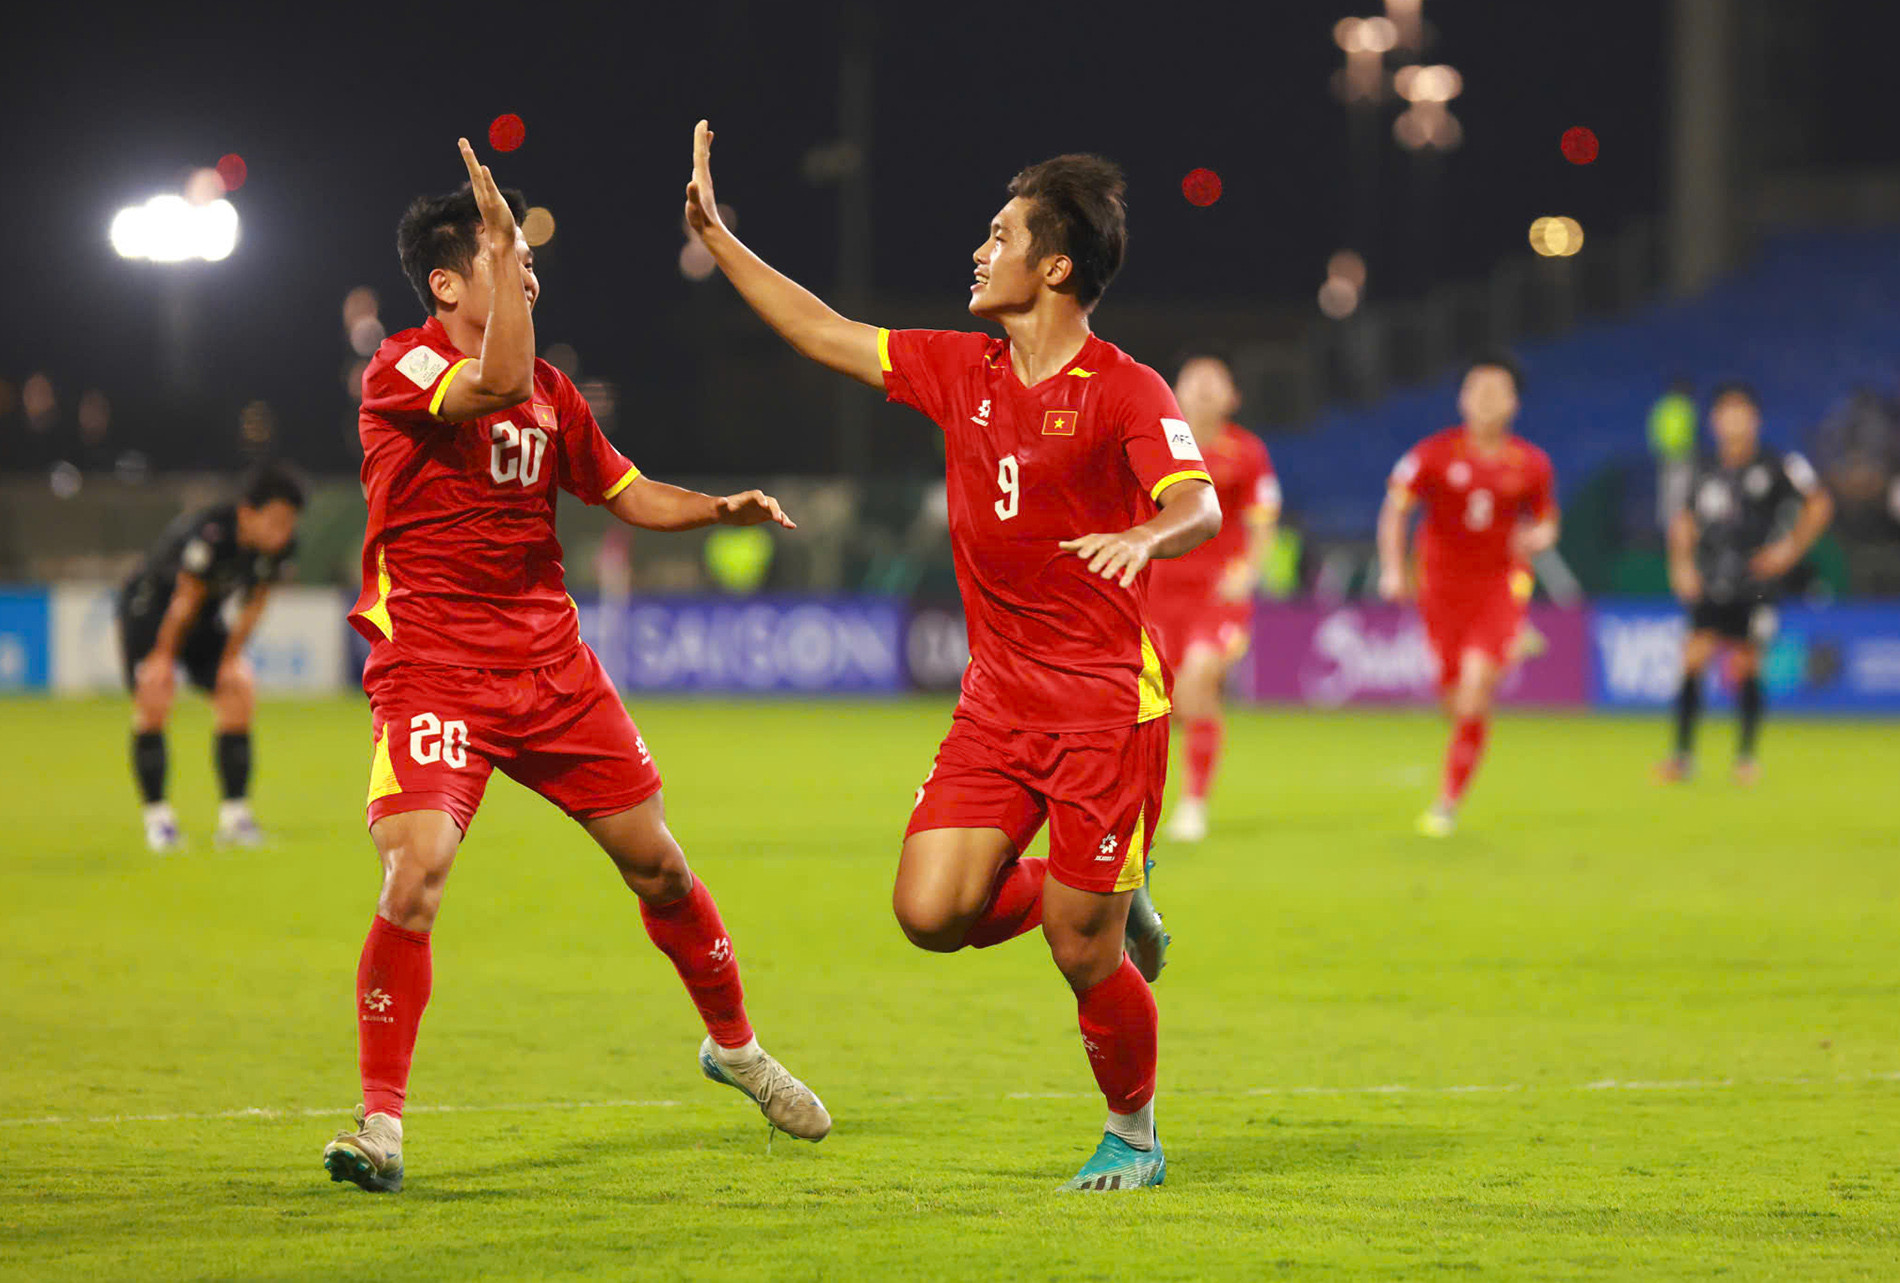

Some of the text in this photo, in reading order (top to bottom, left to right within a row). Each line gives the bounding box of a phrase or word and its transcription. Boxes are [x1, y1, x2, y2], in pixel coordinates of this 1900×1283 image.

[491, 420, 548, 487] 20
[994, 455, 1019, 521] 9
[410, 712, 470, 768] 20
